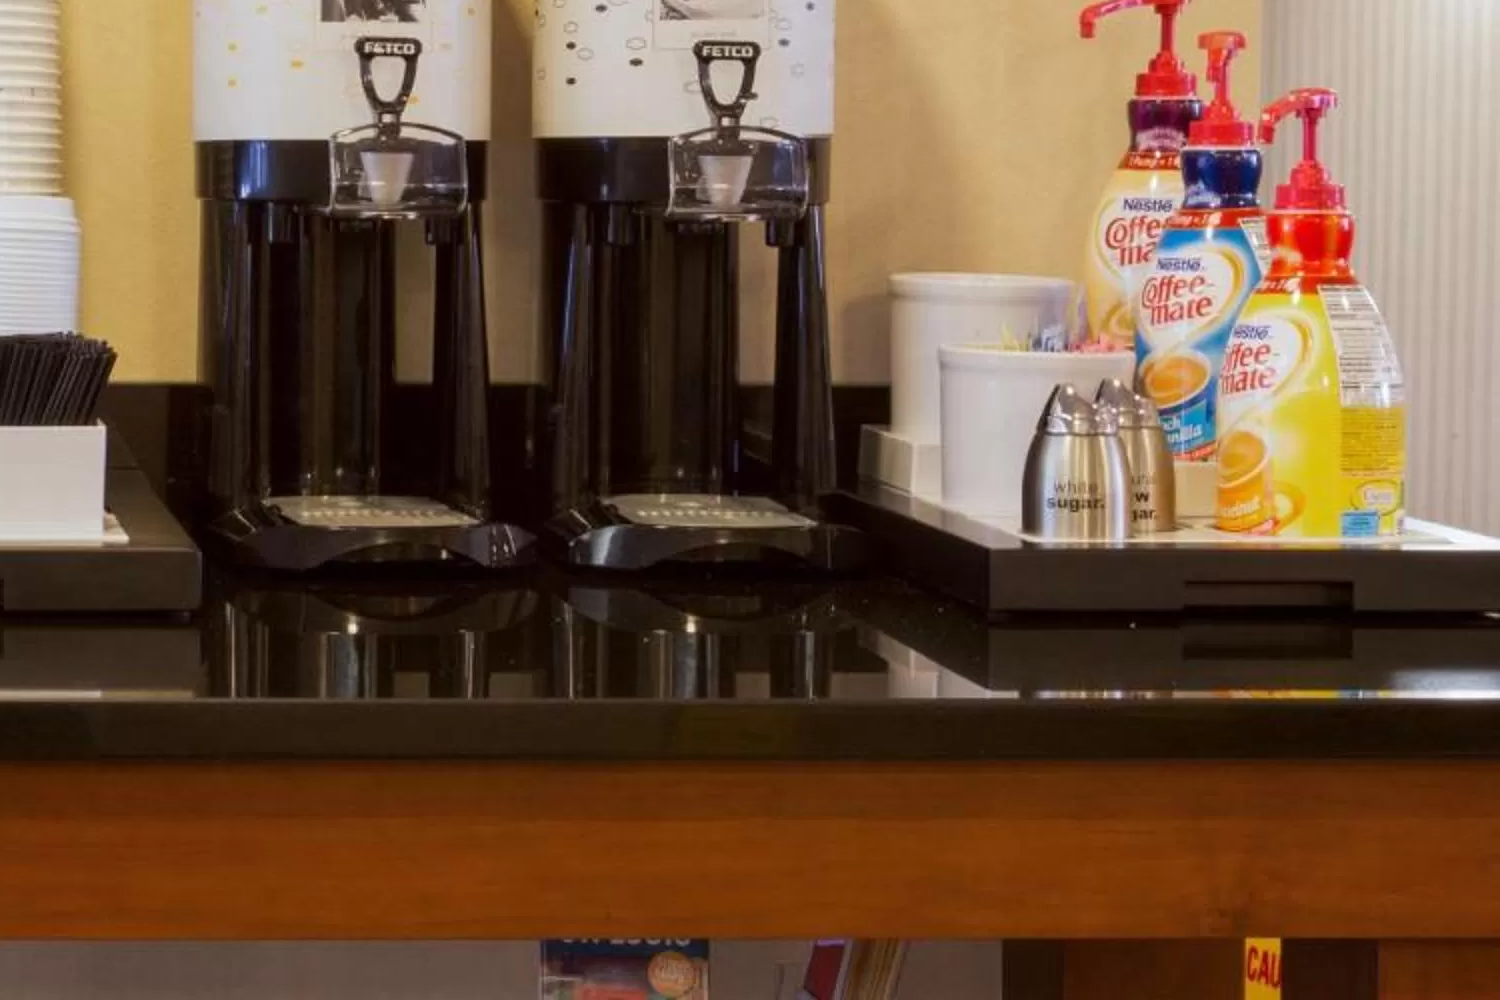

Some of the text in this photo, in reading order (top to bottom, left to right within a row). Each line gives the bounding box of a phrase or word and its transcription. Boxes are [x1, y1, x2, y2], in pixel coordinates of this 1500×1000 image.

[702, 45, 754, 58] FETCO
[1105, 215, 1162, 250] Coffe
[1150, 296, 1213, 326] mate
[1046, 497, 1105, 513] sugar.
